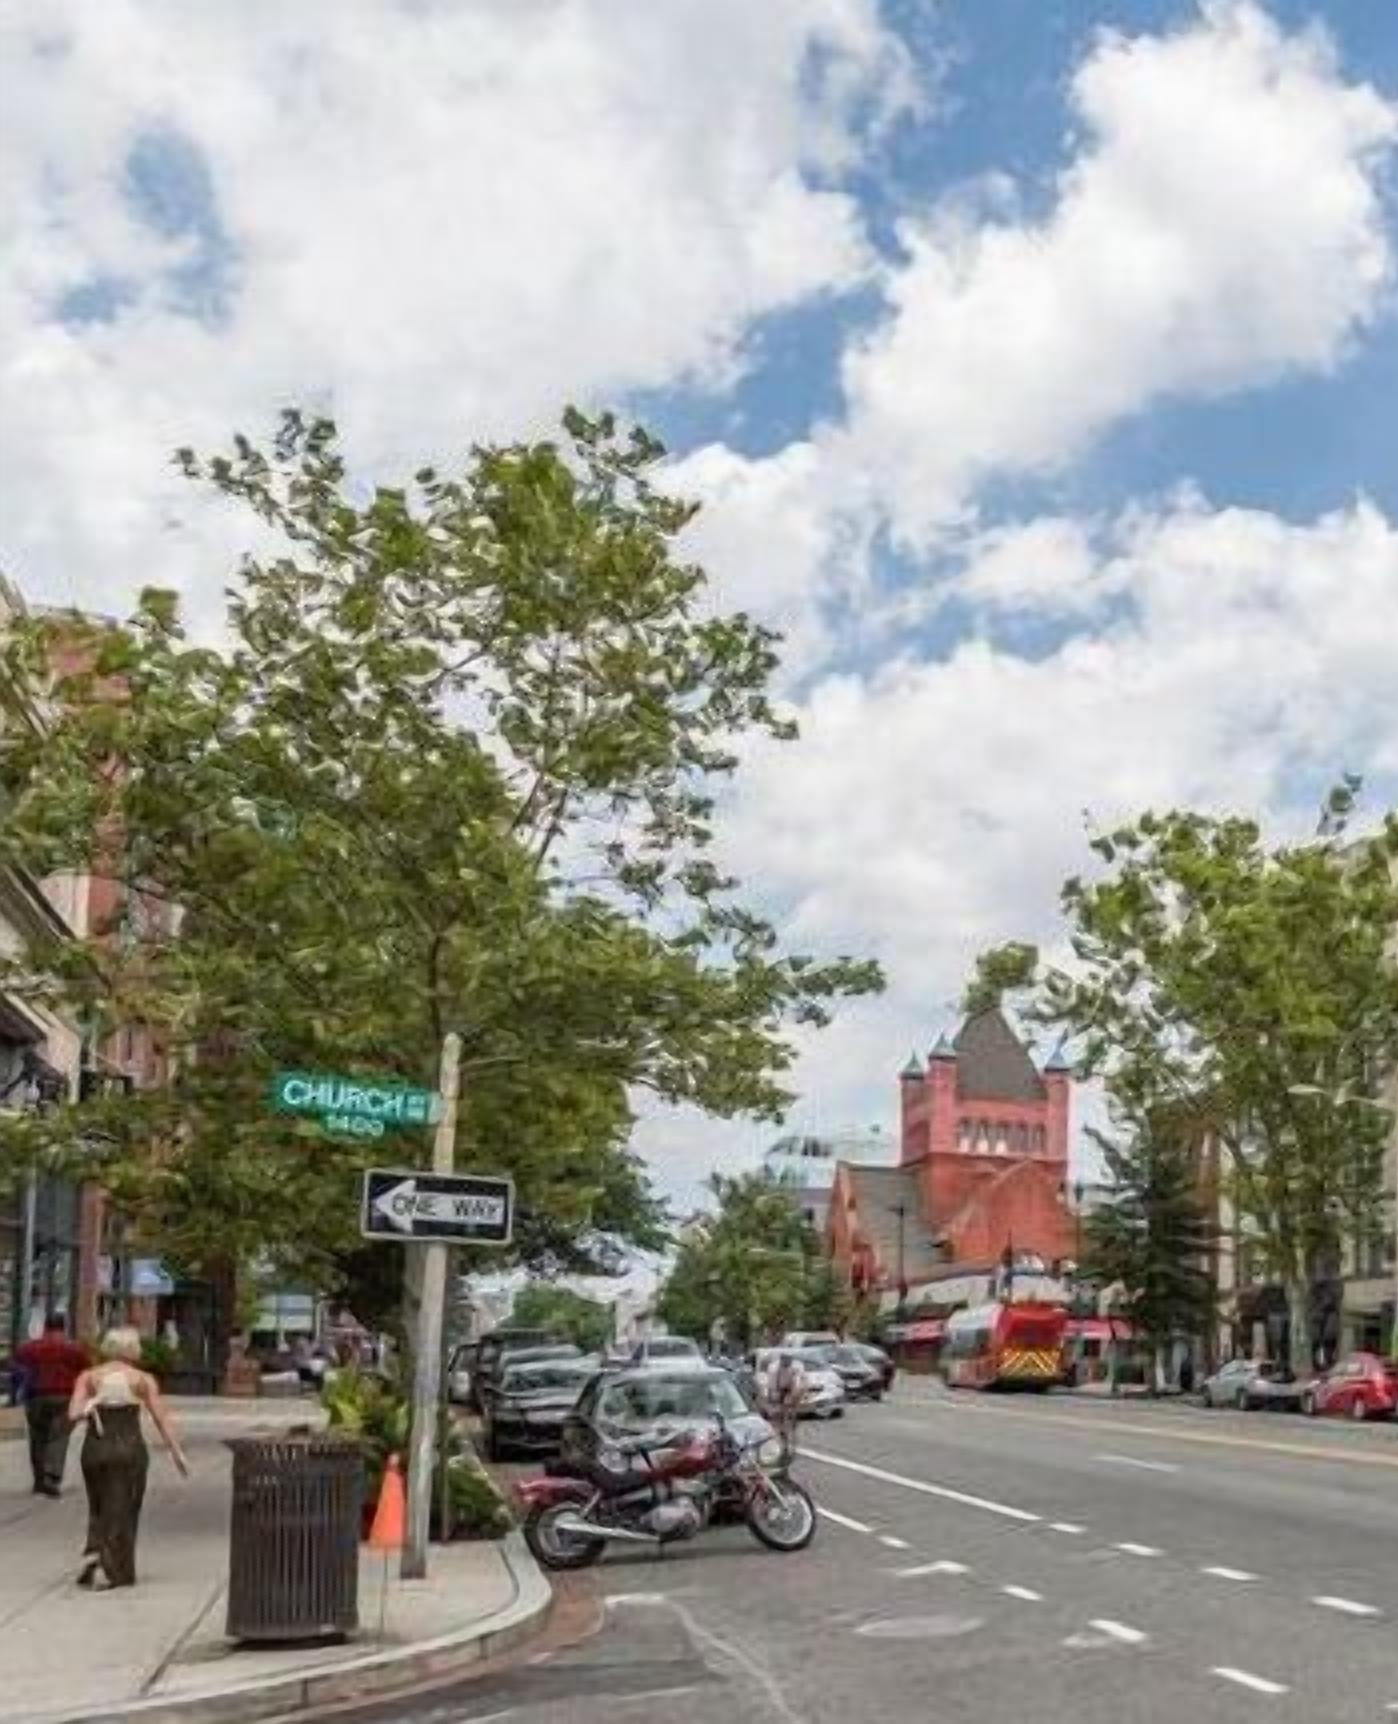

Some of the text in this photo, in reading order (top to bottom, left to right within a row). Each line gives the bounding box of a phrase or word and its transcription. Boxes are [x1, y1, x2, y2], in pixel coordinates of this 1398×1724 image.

[283, 1079, 403, 1118] CHURCH
[392, 1195, 501, 1217] ONE WAY
